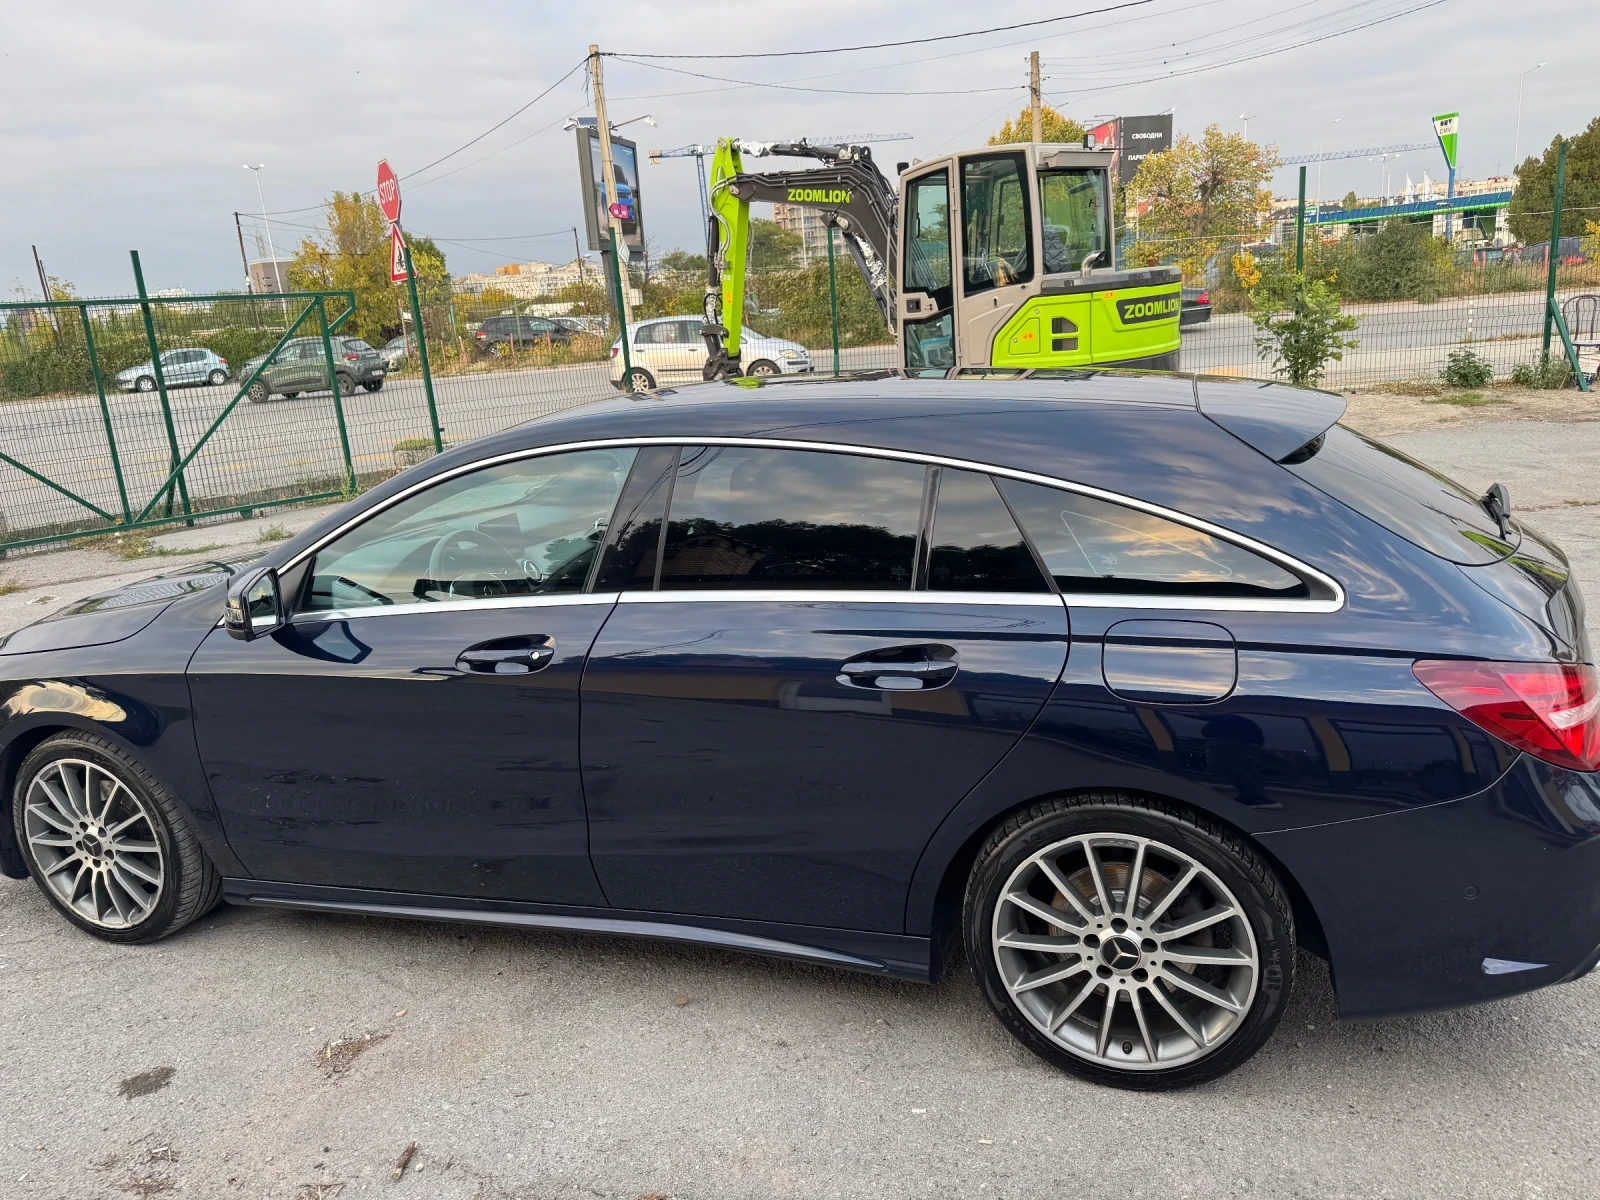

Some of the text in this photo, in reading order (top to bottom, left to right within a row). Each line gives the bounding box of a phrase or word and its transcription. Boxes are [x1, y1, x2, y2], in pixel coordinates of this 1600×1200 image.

[1131, 132, 1163, 140] СВОБОДНИ
[379, 178, 396, 205] STOP
[787, 188, 851, 204] ZOOMLION
[1124, 297, 1180, 319] ZOOMLION
